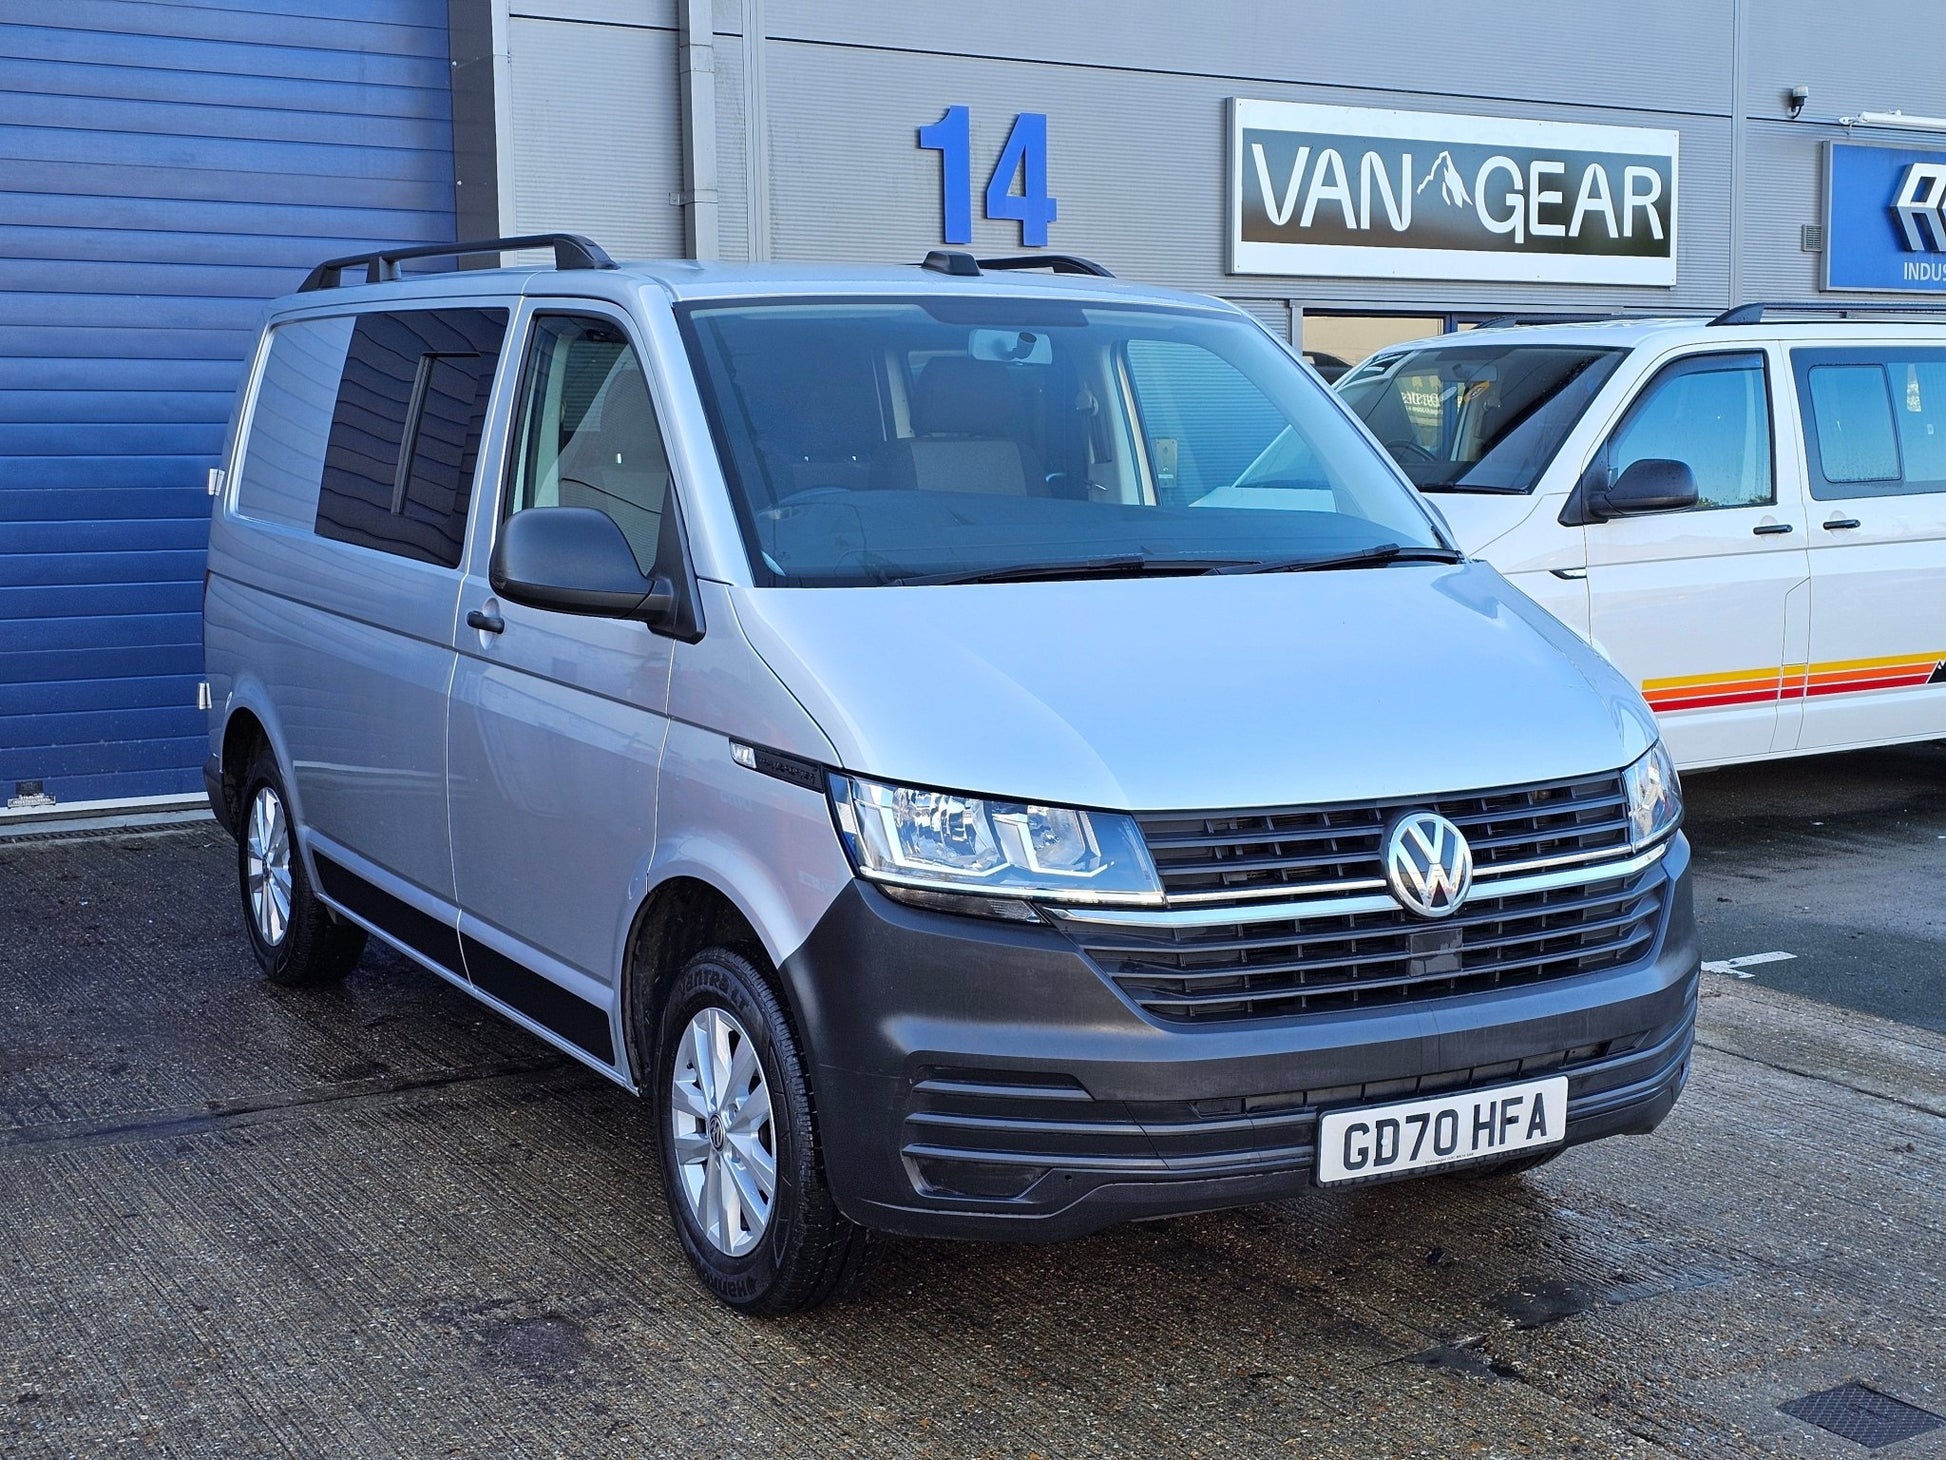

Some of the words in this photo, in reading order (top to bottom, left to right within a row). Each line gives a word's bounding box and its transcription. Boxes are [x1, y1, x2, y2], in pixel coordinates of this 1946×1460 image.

[919, 104, 1057, 247] 14
[1252, 143, 1412, 232] VAN
[1474, 155, 1665, 244] GEAR
[1343, 1108, 1459, 1171] GD70
[1471, 1092, 1548, 1151] HFA
